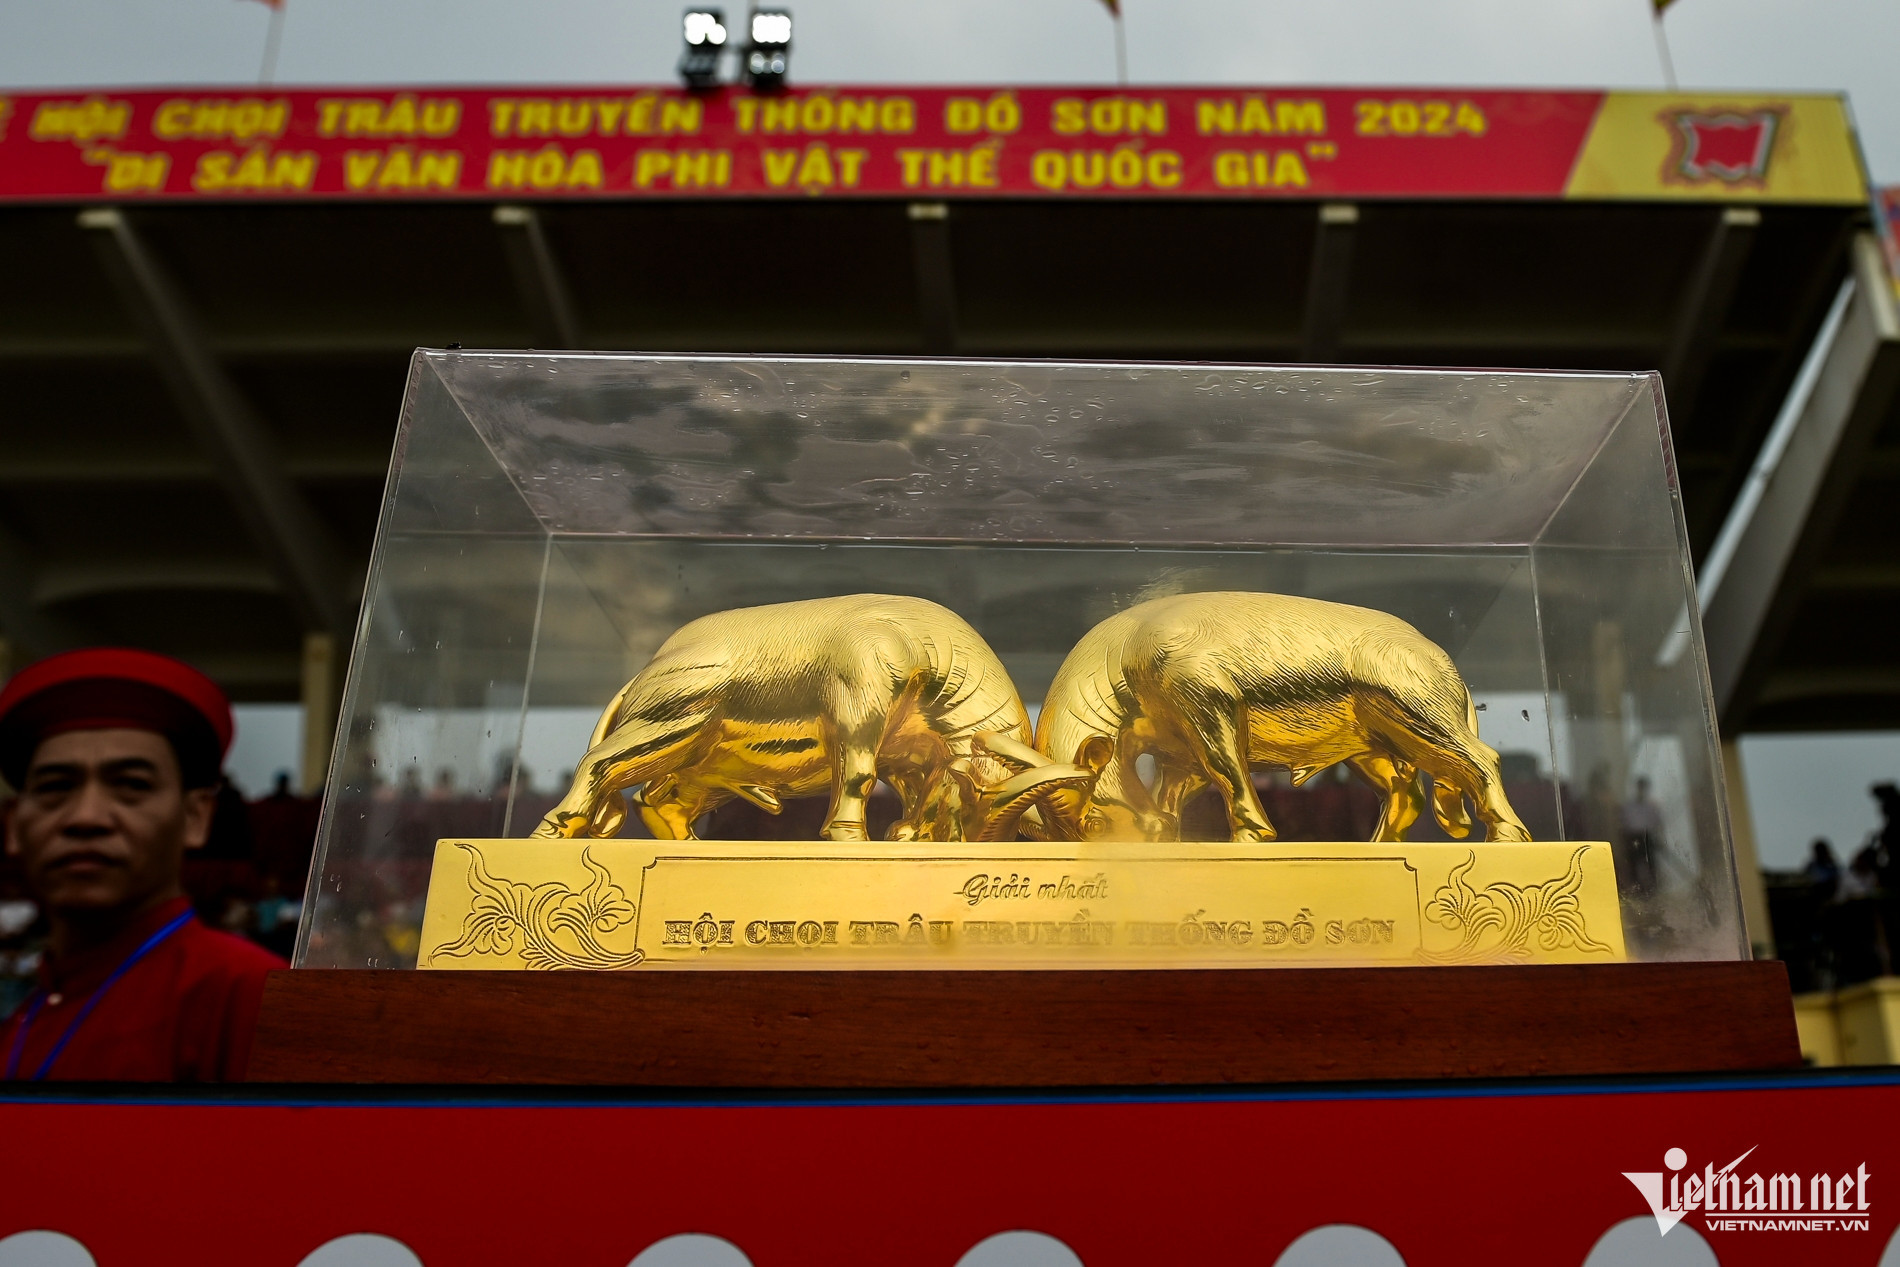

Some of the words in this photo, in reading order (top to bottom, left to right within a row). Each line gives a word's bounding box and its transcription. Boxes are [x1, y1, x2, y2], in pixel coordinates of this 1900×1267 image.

[319, 94, 460, 134] TRÂU
[1355, 100, 1487, 135] 2024
[634, 150, 732, 187] PHI
[662, 912, 736, 955] HỘI
[848, 912, 955, 948] TRÂU
[1261, 908, 1315, 948] ĐỒ
